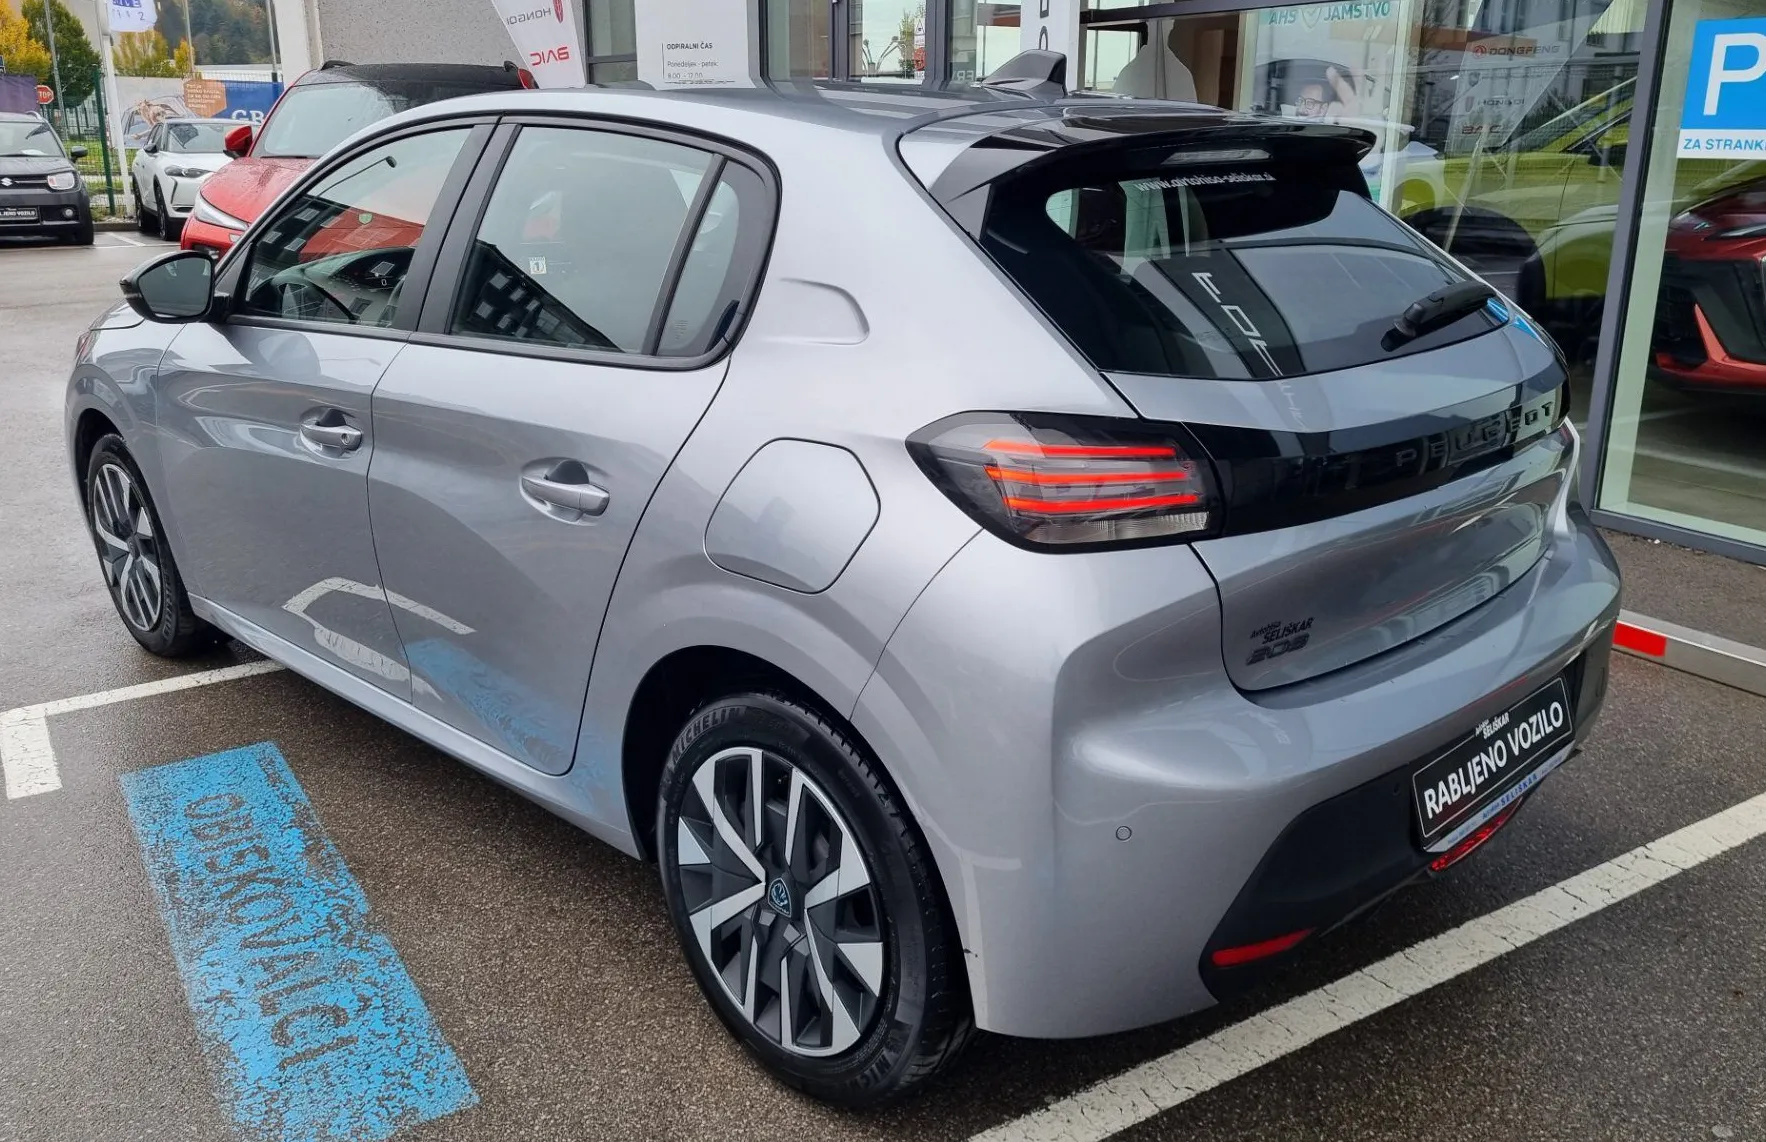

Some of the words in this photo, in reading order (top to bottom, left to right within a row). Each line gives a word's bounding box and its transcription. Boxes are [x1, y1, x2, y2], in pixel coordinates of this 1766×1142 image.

[1268, 10, 1297, 25] AHS
[1323, 1, 1390, 21] JAMSTVO
[700, 41, 713, 49] ČAS
[1489, 46, 1560, 55] DONGFENG
[1703, 32, 1766, 116] P
[39, 91, 51, 99] TOP
[1462, 125, 1501, 134] BAC
[1683, 139, 1701, 150] ZA
[1705, 139, 1766, 150] STRANK
[1396, 402, 1553, 467] PEUGEOT
[671, 705, 747, 764] MICHELIN
[1483, 712, 1510, 740] SELIŠKAR
[1423, 739, 1507, 819] RABLJENO
[1507, 701, 1564, 757] VOZILO
[184, 793, 360, 1070] OBISKOVALCI
